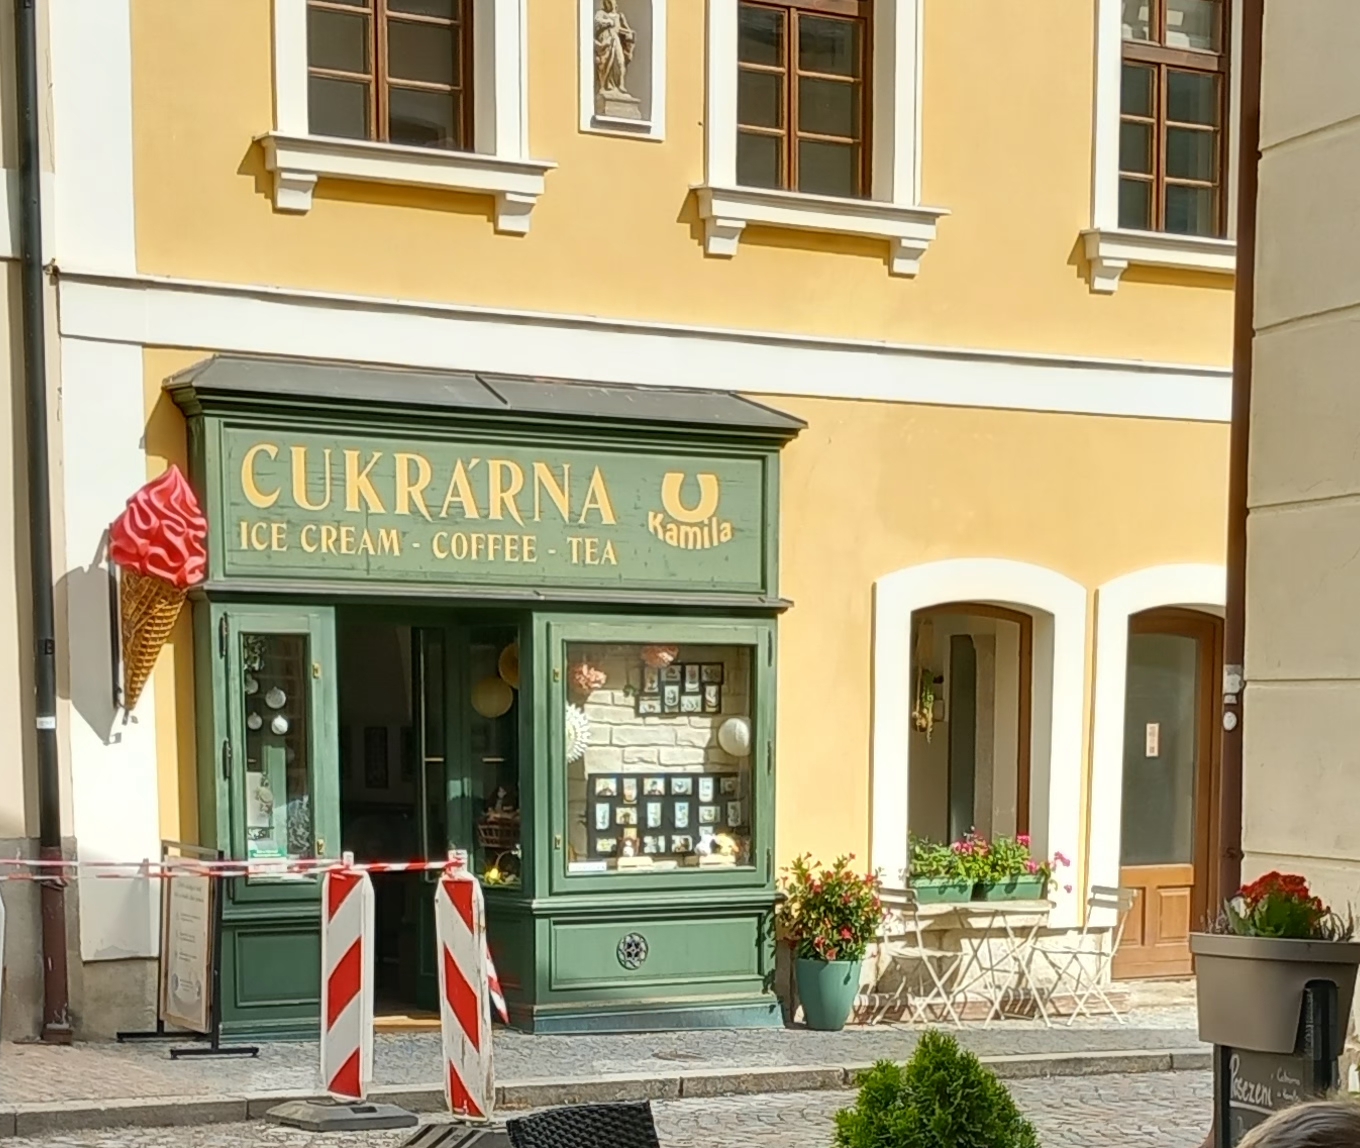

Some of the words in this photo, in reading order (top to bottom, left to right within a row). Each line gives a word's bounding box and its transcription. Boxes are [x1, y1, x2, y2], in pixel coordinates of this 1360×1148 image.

[240, 442, 618, 527] CUKRÁRNA
[240, 521, 288, 552] ICE
[300, 524, 402, 557] CREAM
[432, 531, 538, 563] COFFEE
[566, 536, 618, 567] TEA
[647, 510, 733, 550] Kamila
